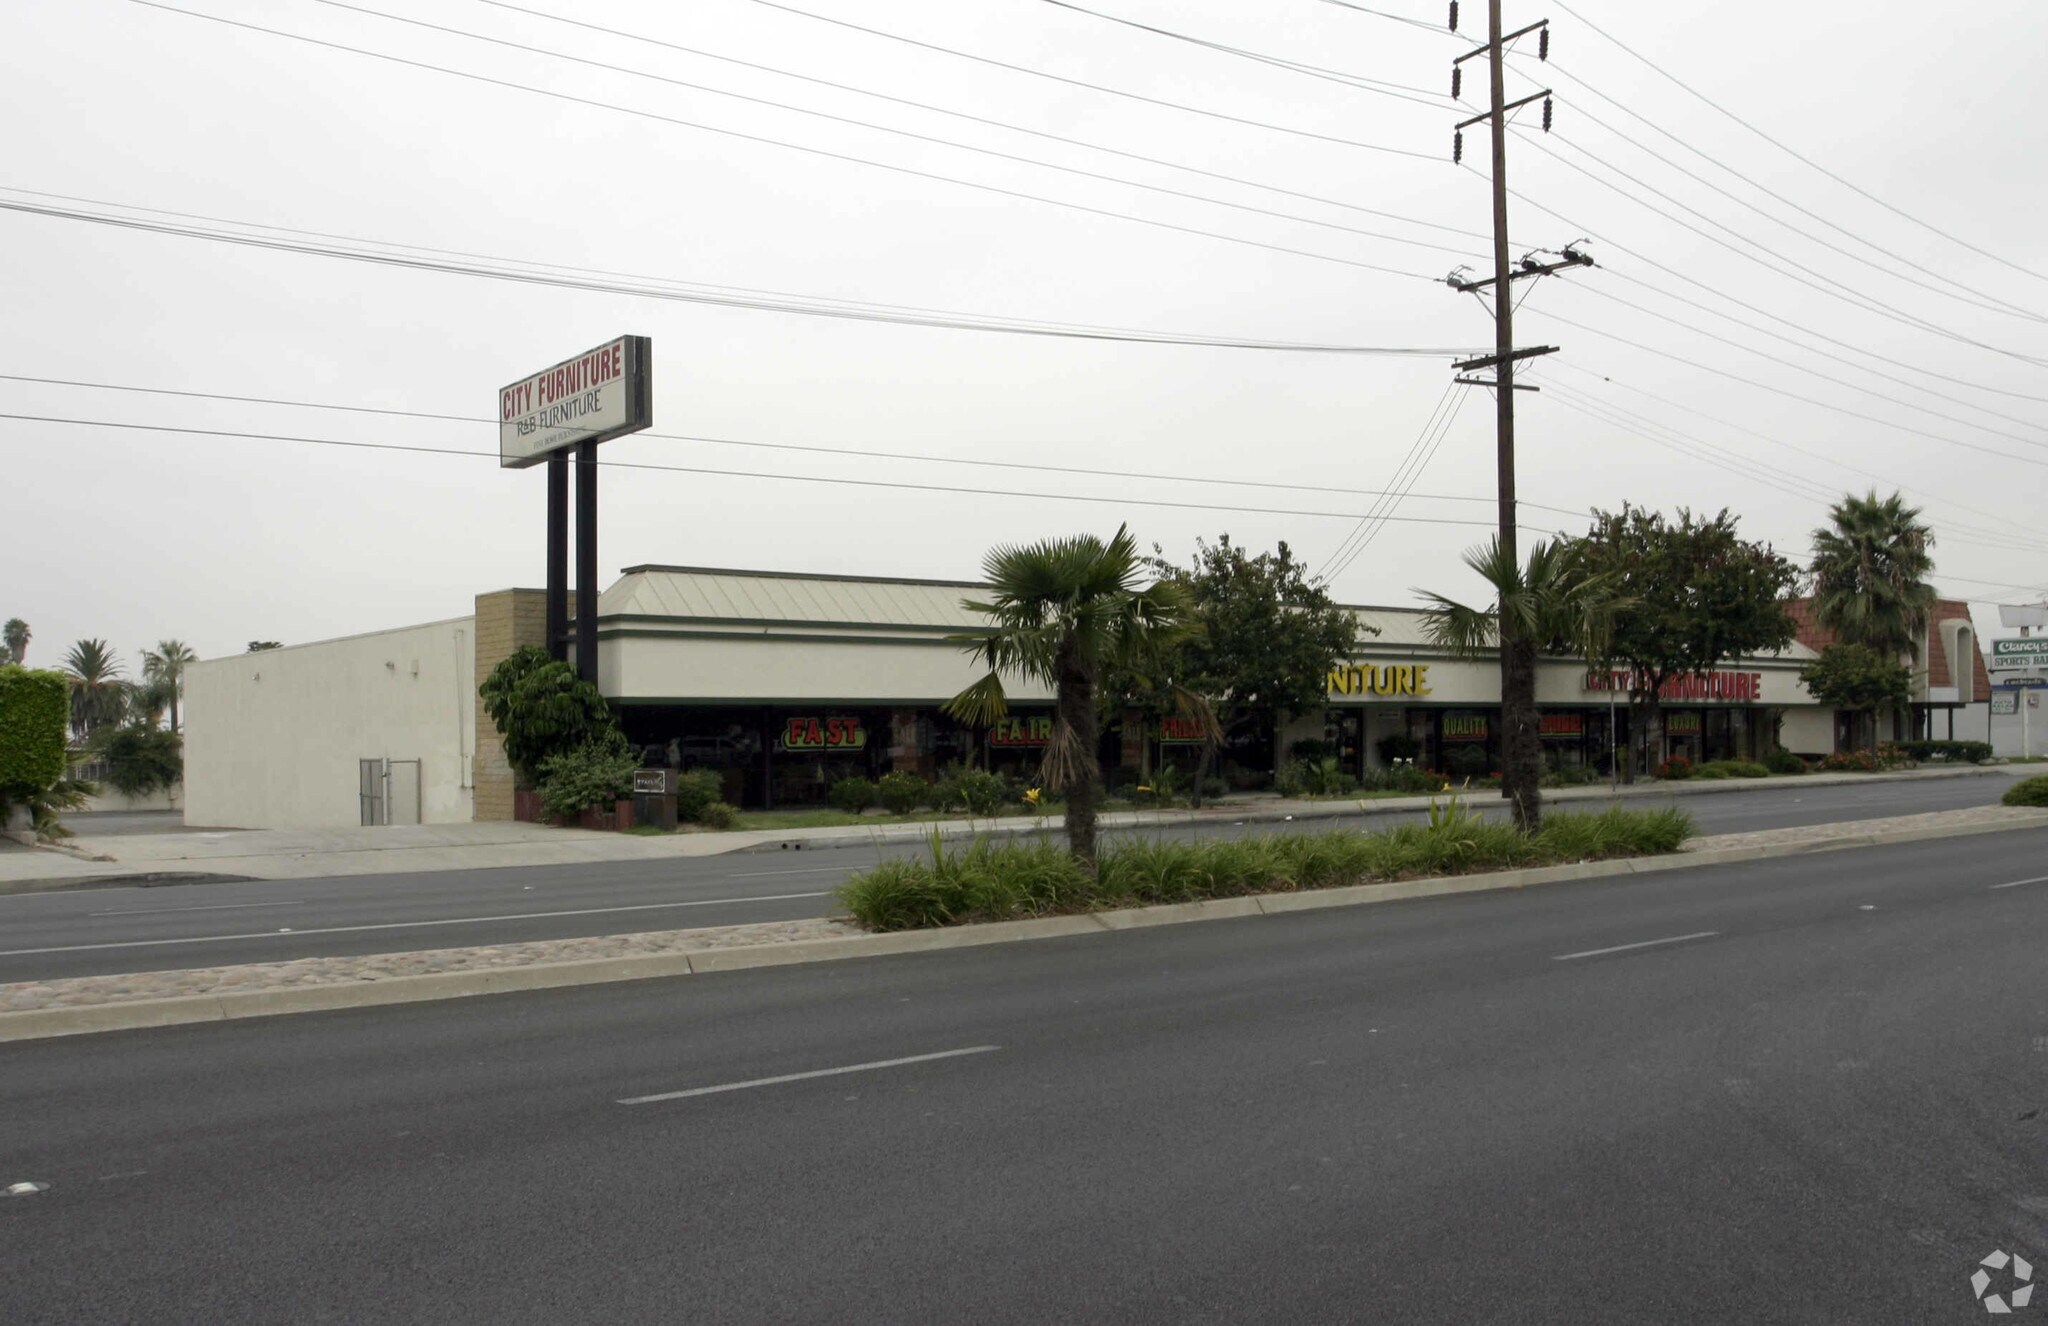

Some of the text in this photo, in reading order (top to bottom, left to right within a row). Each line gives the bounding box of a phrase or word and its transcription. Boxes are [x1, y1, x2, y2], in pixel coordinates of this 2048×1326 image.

[503, 344, 621, 421] CITY FURNITURE
[517, 416, 537, 437] R&B
[540, 389, 602, 429] FURNITURE
[1994, 656, 2030, 667] SPORTS
[788, 718, 860, 744] FAST
[996, 719, 1055, 741] FAIR
[1443, 716, 1487, 737] QUALITY
